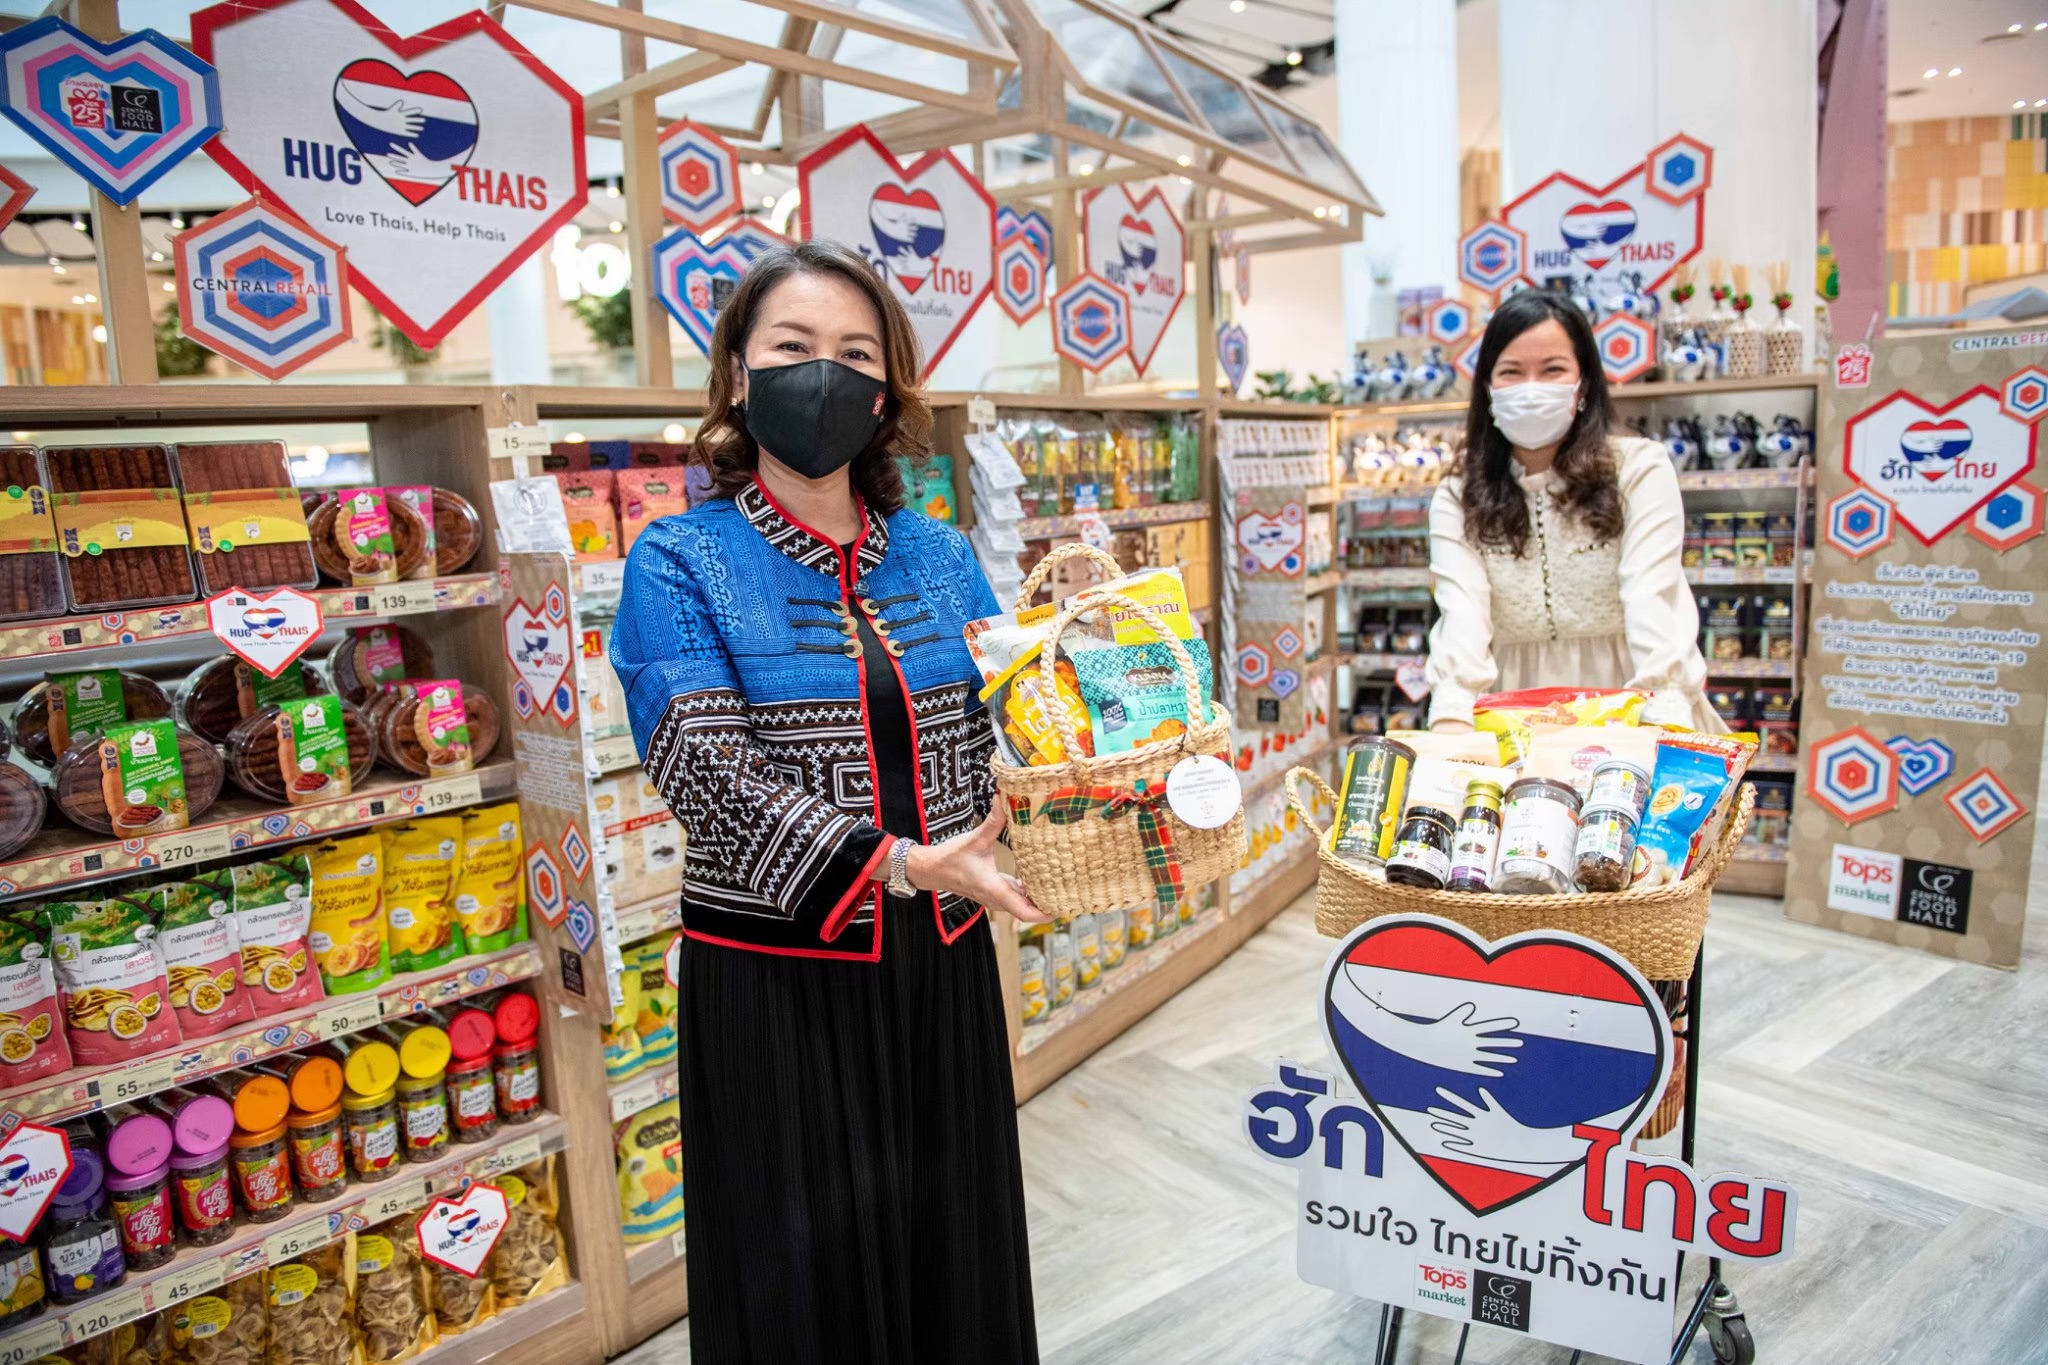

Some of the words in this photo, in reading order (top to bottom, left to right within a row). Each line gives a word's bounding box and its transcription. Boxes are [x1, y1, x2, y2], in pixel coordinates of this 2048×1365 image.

[121, 113, 154, 122] FOOD
[122, 121, 155, 130] HALL
[283, 138, 362, 185] HUG
[451, 164, 548, 211] THAIS
[325, 206, 365, 225] Love
[423, 219, 461, 238] Help
[466, 224, 506, 242] Thais
[1535, 250, 1571, 269] HUG
[1620, 242, 1675, 263] THAIS
[930, 256, 972, 295] ไทย
[1953, 332, 2048, 350] CENTRALRET
[502, 438, 520, 449] 15
[1881, 459, 1912, 480] ฮัก
[1955, 458, 1997, 479] ไทย
[592, 574, 605, 584] 35
[382, 595, 406, 608] 139
[230, 628, 252, 637] HUG
[278, 626, 309, 636] THAIS
[516, 651, 530, 662] HUG
[544, 652, 564, 666] THAIS
[1131, 671, 1171, 682] KUNNA
[1103, 702, 1124, 718] 100%
[428, 792, 453, 807] 139
[163, 845, 193, 862] 270
[1838, 854, 1894, 884] Tops
[1834, 885, 1891, 905] market
[1911, 890, 1957, 904] CENTRAL
[1909, 900, 1957, 915] FOOD
[1908, 909, 1955, 928] HALL
[331, 1017, 349, 1032] 50
[117, 1080, 138, 1097] 55
[1248, 1066, 1384, 1178] ฮัก
[1572, 1124, 1788, 1258] ไทย
[22, 1167, 58, 1188] THAIS
[380, 1202, 398, 1214] 45
[438, 1239, 456, 1251] HUG
[475, 1219, 499, 1235] THAIS
[280, 1240, 299, 1255] 45
[1305, 1200, 1417, 1246] รวมใจ
[1430, 1217, 1666, 1302] ไทยไม่ทิ้งกัน
[1418, 1264, 1467, 1290] Tops
[168, 1282, 189, 1300] 45
[1417, 1288, 1466, 1306] market
[1482, 1295, 1520, 1309] CENTRAL
[1482, 1301, 1520, 1317] FOOD
[77, 1314, 109, 1336] 120
[1481, 1310, 1519, 1327] HALL
